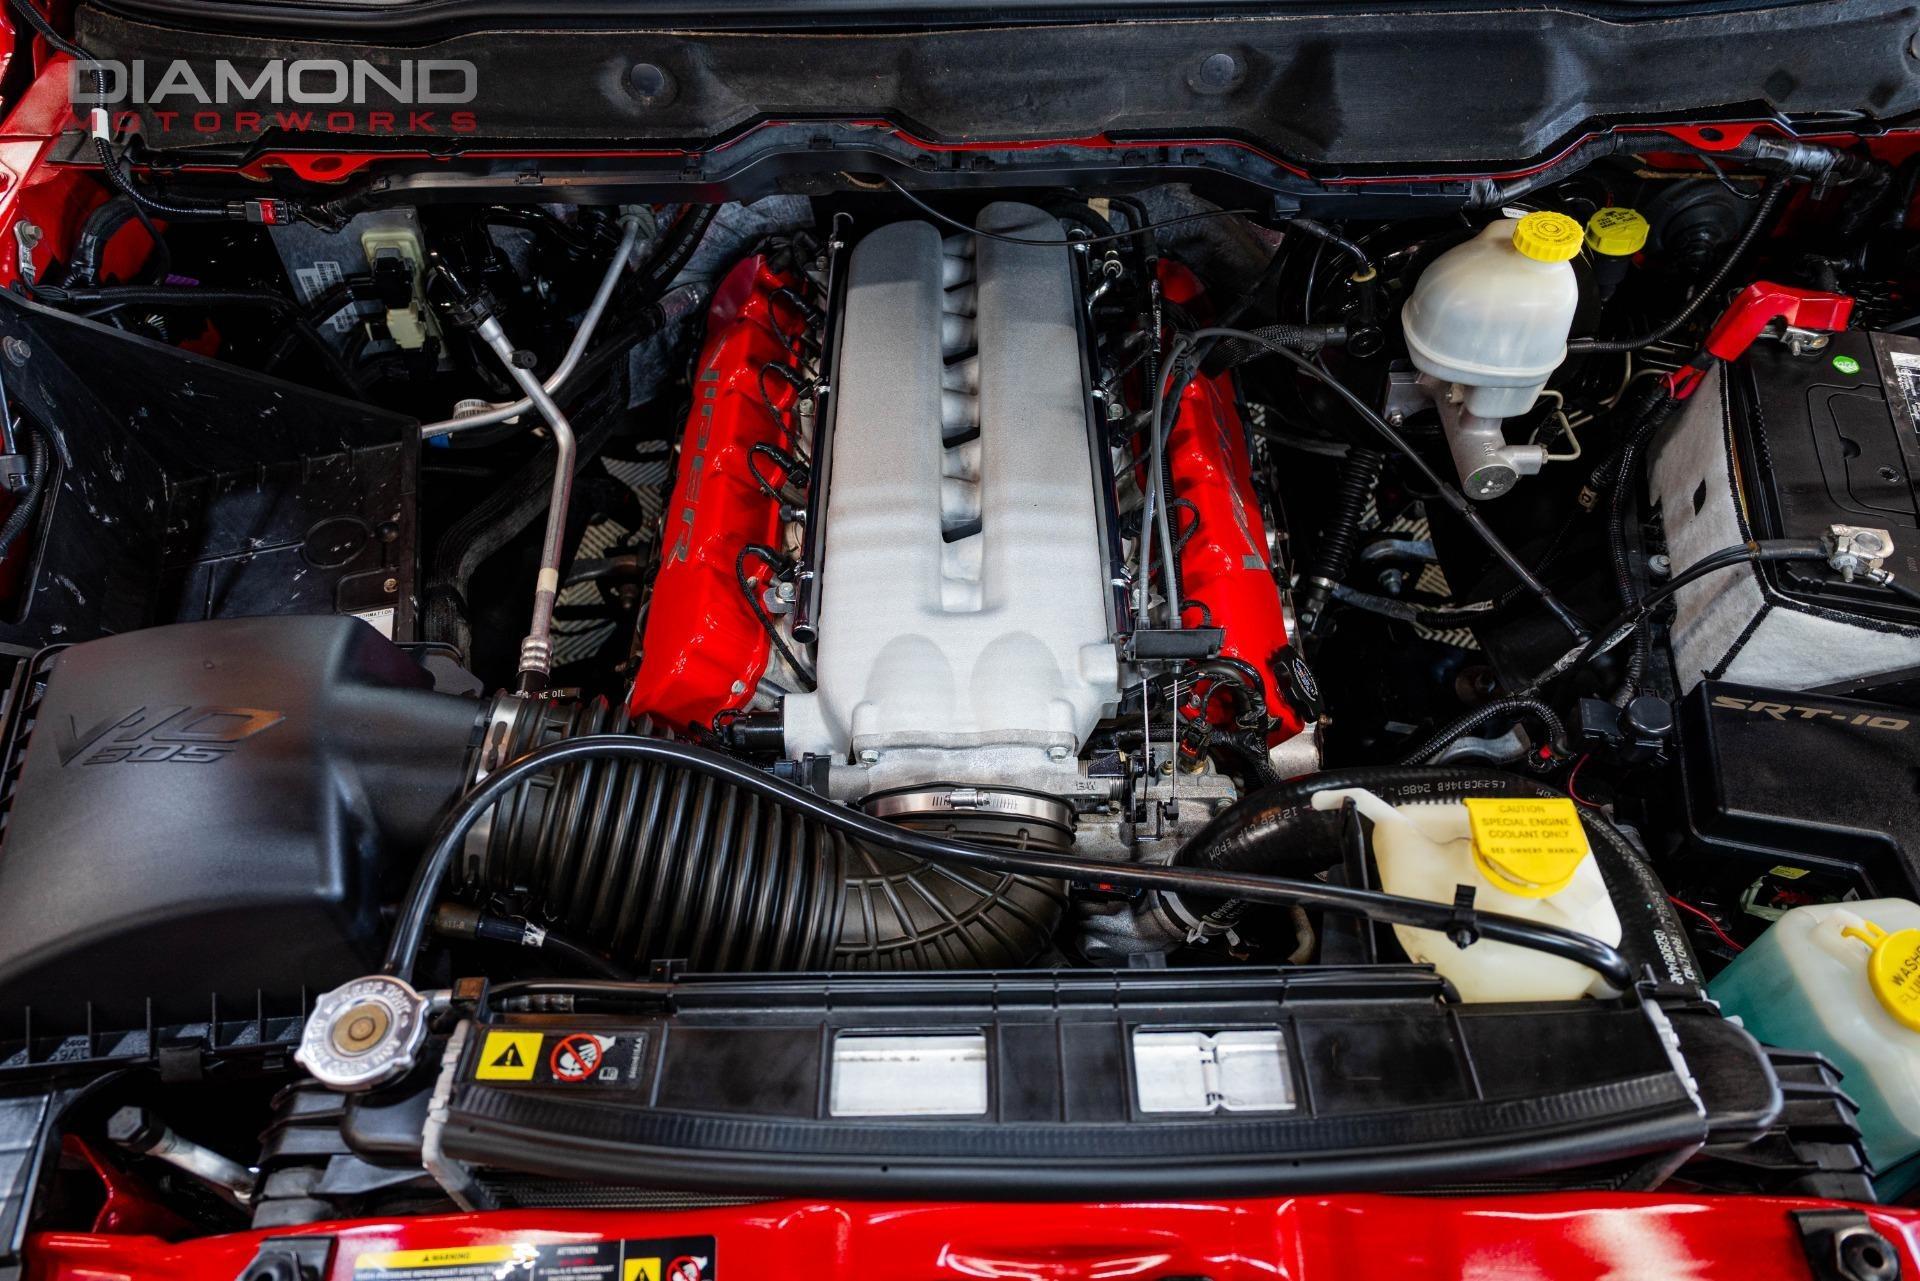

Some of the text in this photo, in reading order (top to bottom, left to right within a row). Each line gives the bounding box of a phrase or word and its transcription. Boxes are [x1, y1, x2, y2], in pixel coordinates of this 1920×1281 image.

[552, 689, 566, 698] OIL
[1711, 695, 1910, 731] SRT-10
[82, 744, 236, 766] 505
[1498, 804, 1546, 814] CAUTION
[1481, 817, 1572, 827] SPECIAL ENGINE
[1488, 830, 1569, 839] COOLANT ONLY
